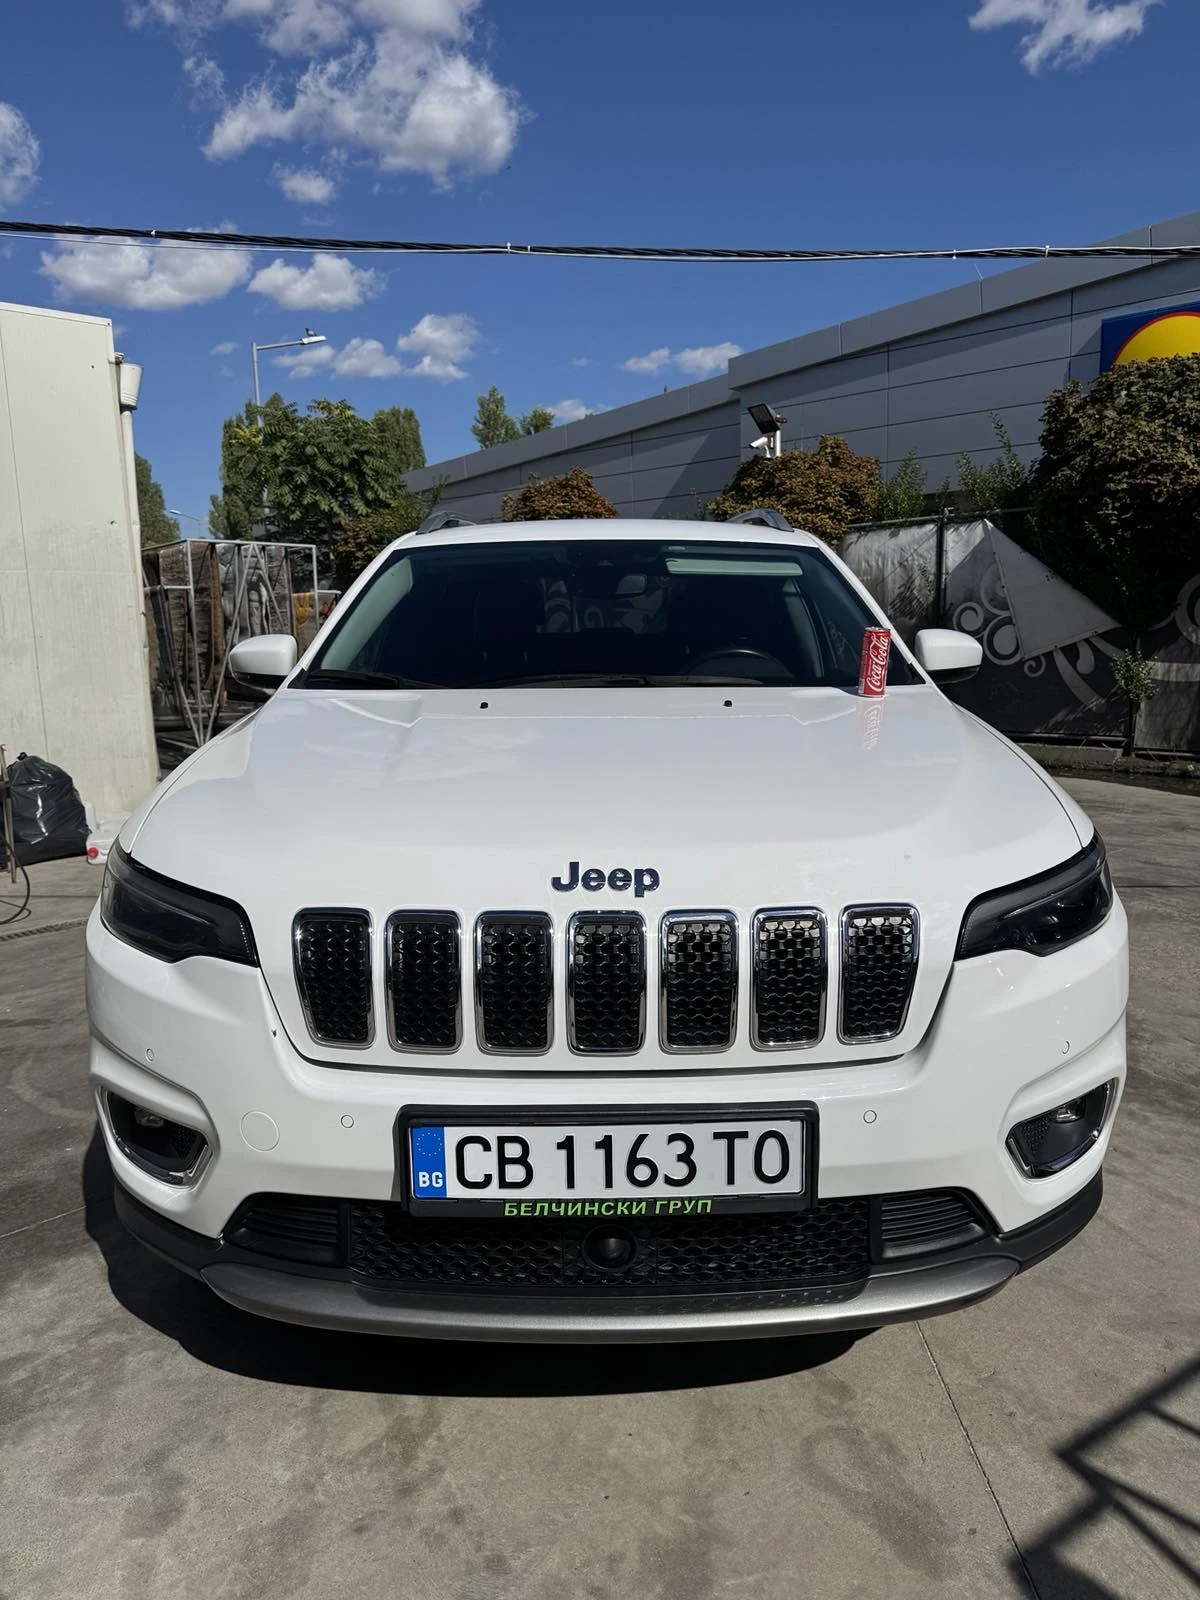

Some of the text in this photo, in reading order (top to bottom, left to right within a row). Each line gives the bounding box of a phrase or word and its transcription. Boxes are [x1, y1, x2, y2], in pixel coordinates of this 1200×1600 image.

[551, 861, 660, 898] Jeep
[455, 1129, 790, 1189] CB 1163 TO
[418, 1171, 443, 1188] BG
[504, 1199, 712, 1216] БЕЛЧИНСКИ ГРУП
